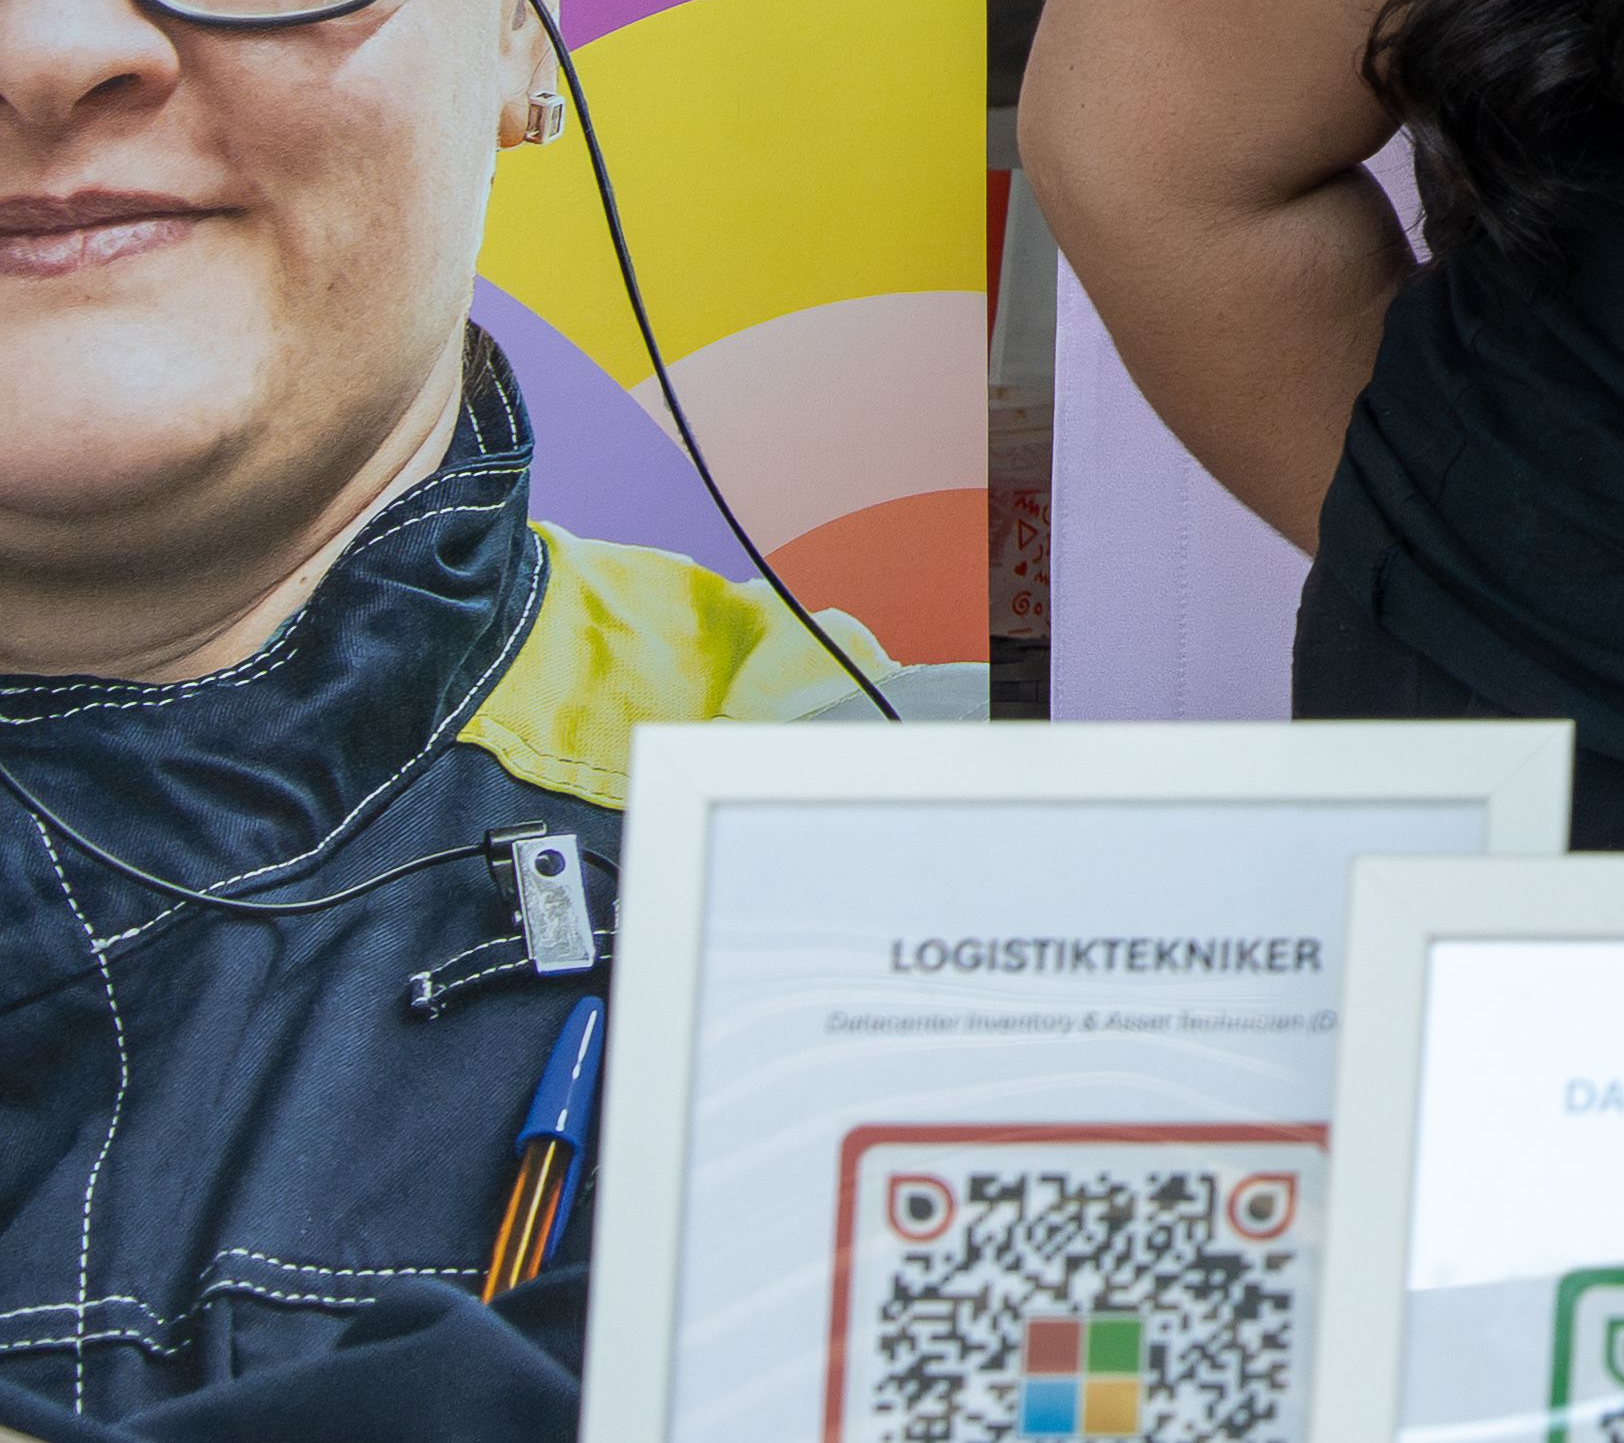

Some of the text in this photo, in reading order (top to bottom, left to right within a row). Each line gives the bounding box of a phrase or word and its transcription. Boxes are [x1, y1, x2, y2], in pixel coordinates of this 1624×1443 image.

[889, 937, 1323, 977] LOGISTIKTEKNIKER
[1081, 1010, 1099, 1031] &
[1105, 1010, 1173, 1031] Asset
